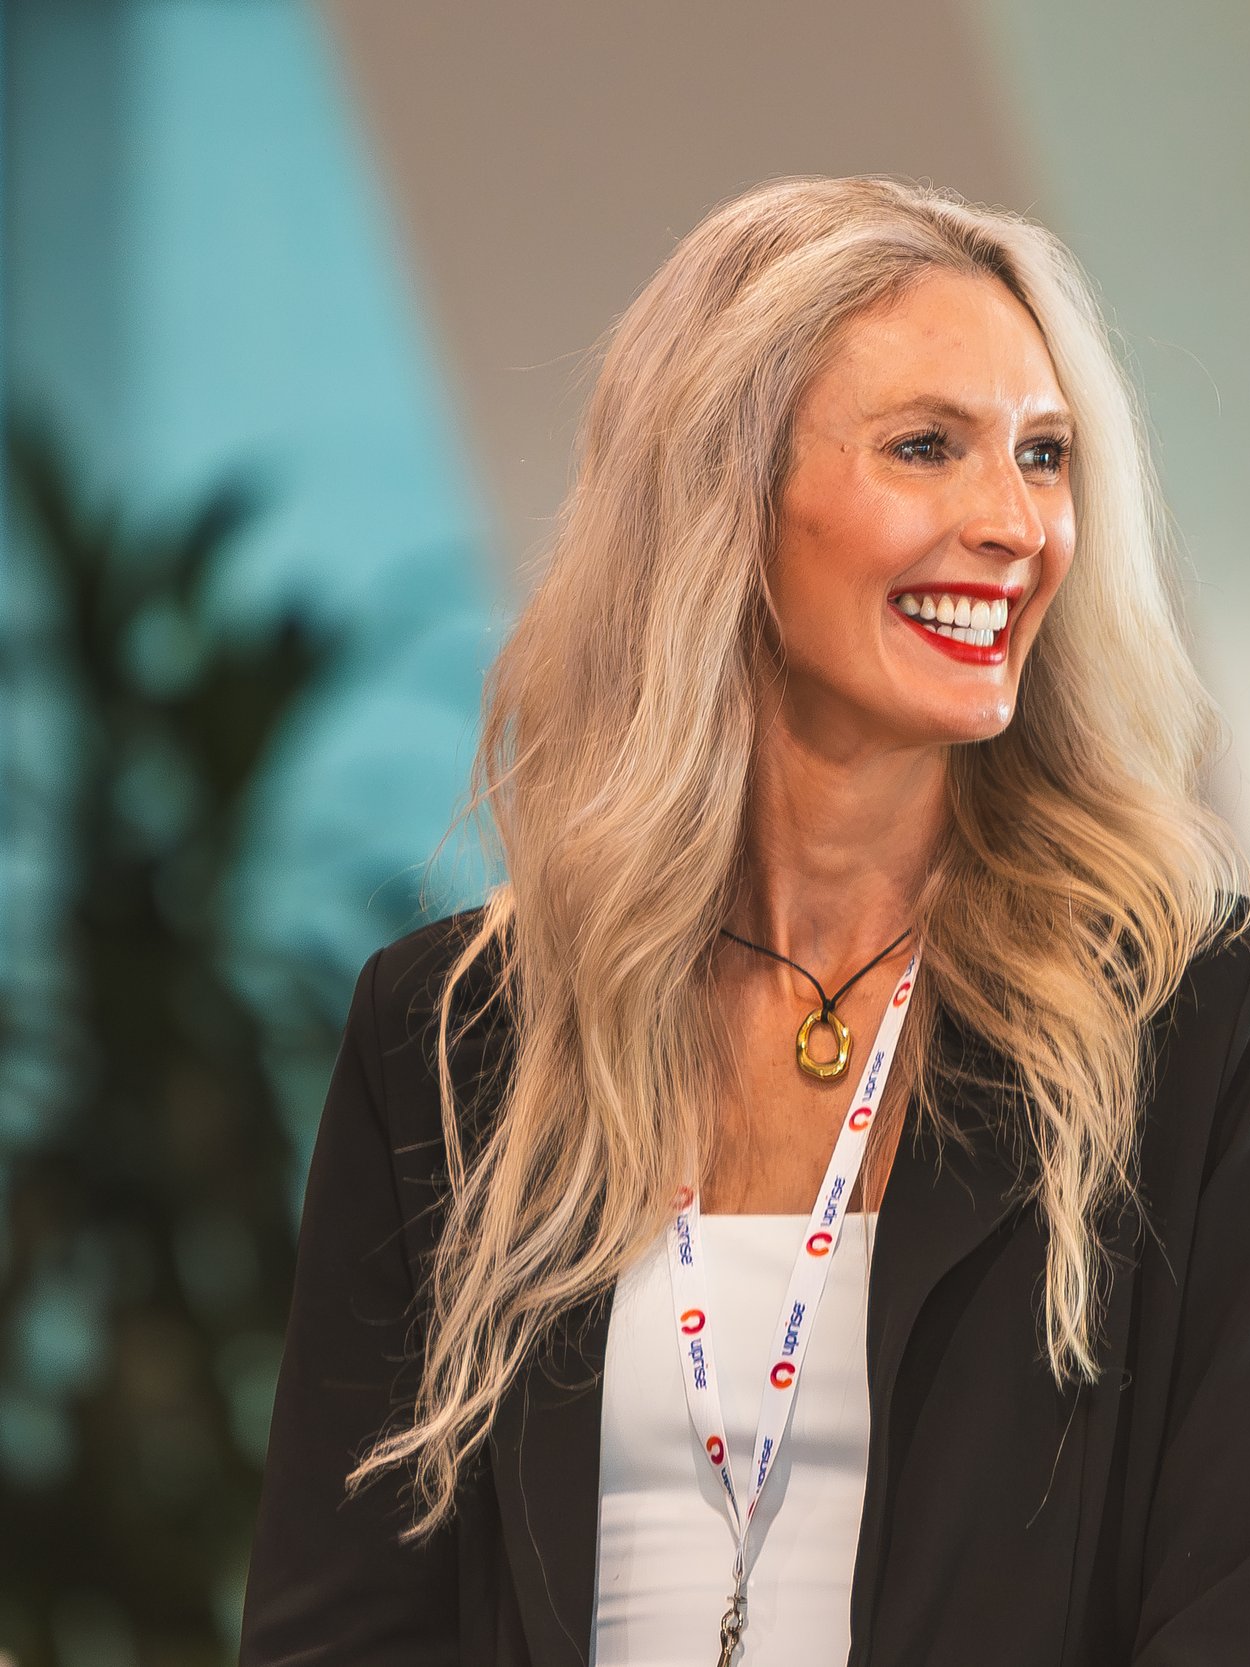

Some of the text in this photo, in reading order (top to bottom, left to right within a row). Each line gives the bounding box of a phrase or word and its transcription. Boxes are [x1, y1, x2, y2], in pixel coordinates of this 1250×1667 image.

[862, 1051, 884, 1101] uprise
[822, 1177, 846, 1226] uprise
[782, 1300, 806, 1356] uprise
[689, 1339, 708, 1390] uprise
